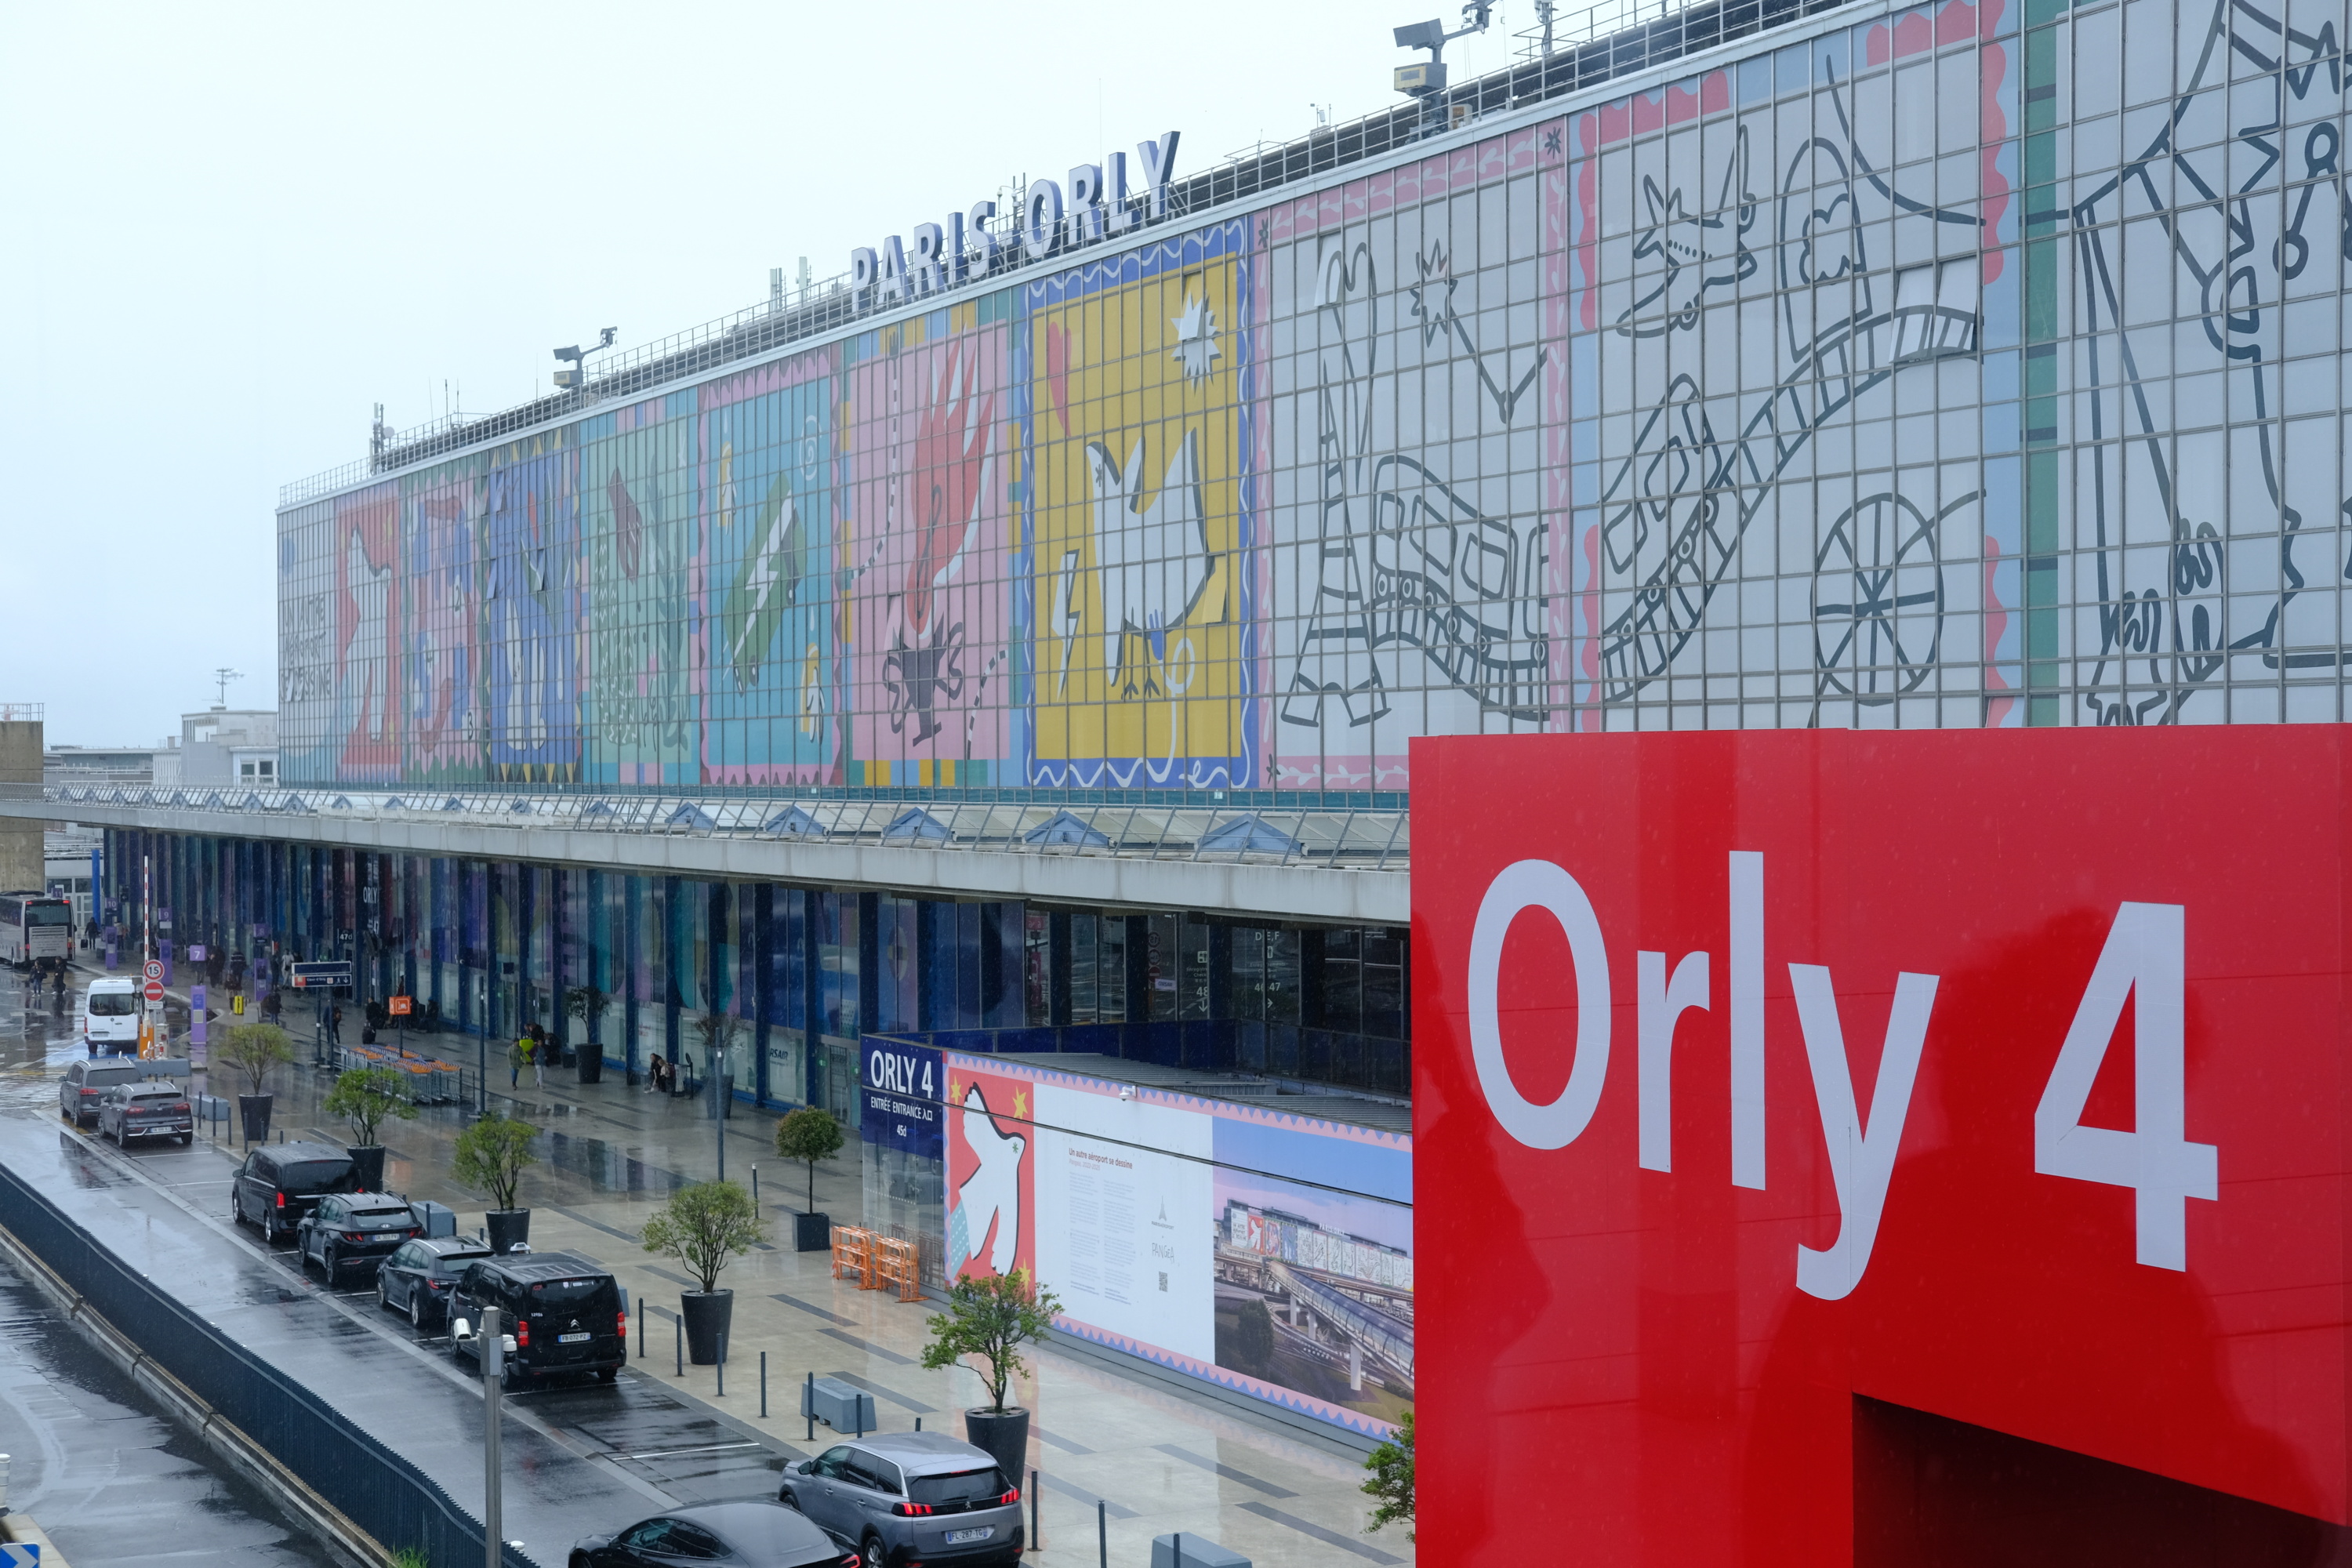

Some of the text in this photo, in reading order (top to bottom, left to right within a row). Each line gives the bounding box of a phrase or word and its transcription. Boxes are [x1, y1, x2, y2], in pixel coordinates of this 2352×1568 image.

[299, 597, 325, 628] AUTRE
[363, 887, 377, 904] ORLY
[163, 911, 169, 920] 9
[194, 951, 201, 960] 7
[148, 966, 159, 975] 15
[870, 1050, 933, 1099] ORLY 4
[1468, 851, 2218, 1300] Orly 4
[871, 1096, 891, 1112] ENTRÉE
[893, 1102, 921, 1120] ENTRANCE
[897, 1124, 907, 1137] 45d
[1069, 1148, 1076, 1157] Un
[1076, 1150, 1087, 1160] autre
[1088, 1152, 1109, 1164] aéroport
[1115, 1158, 1133, 1169] dessine
[952, 1529, 983, 1539] FL-287-TG
